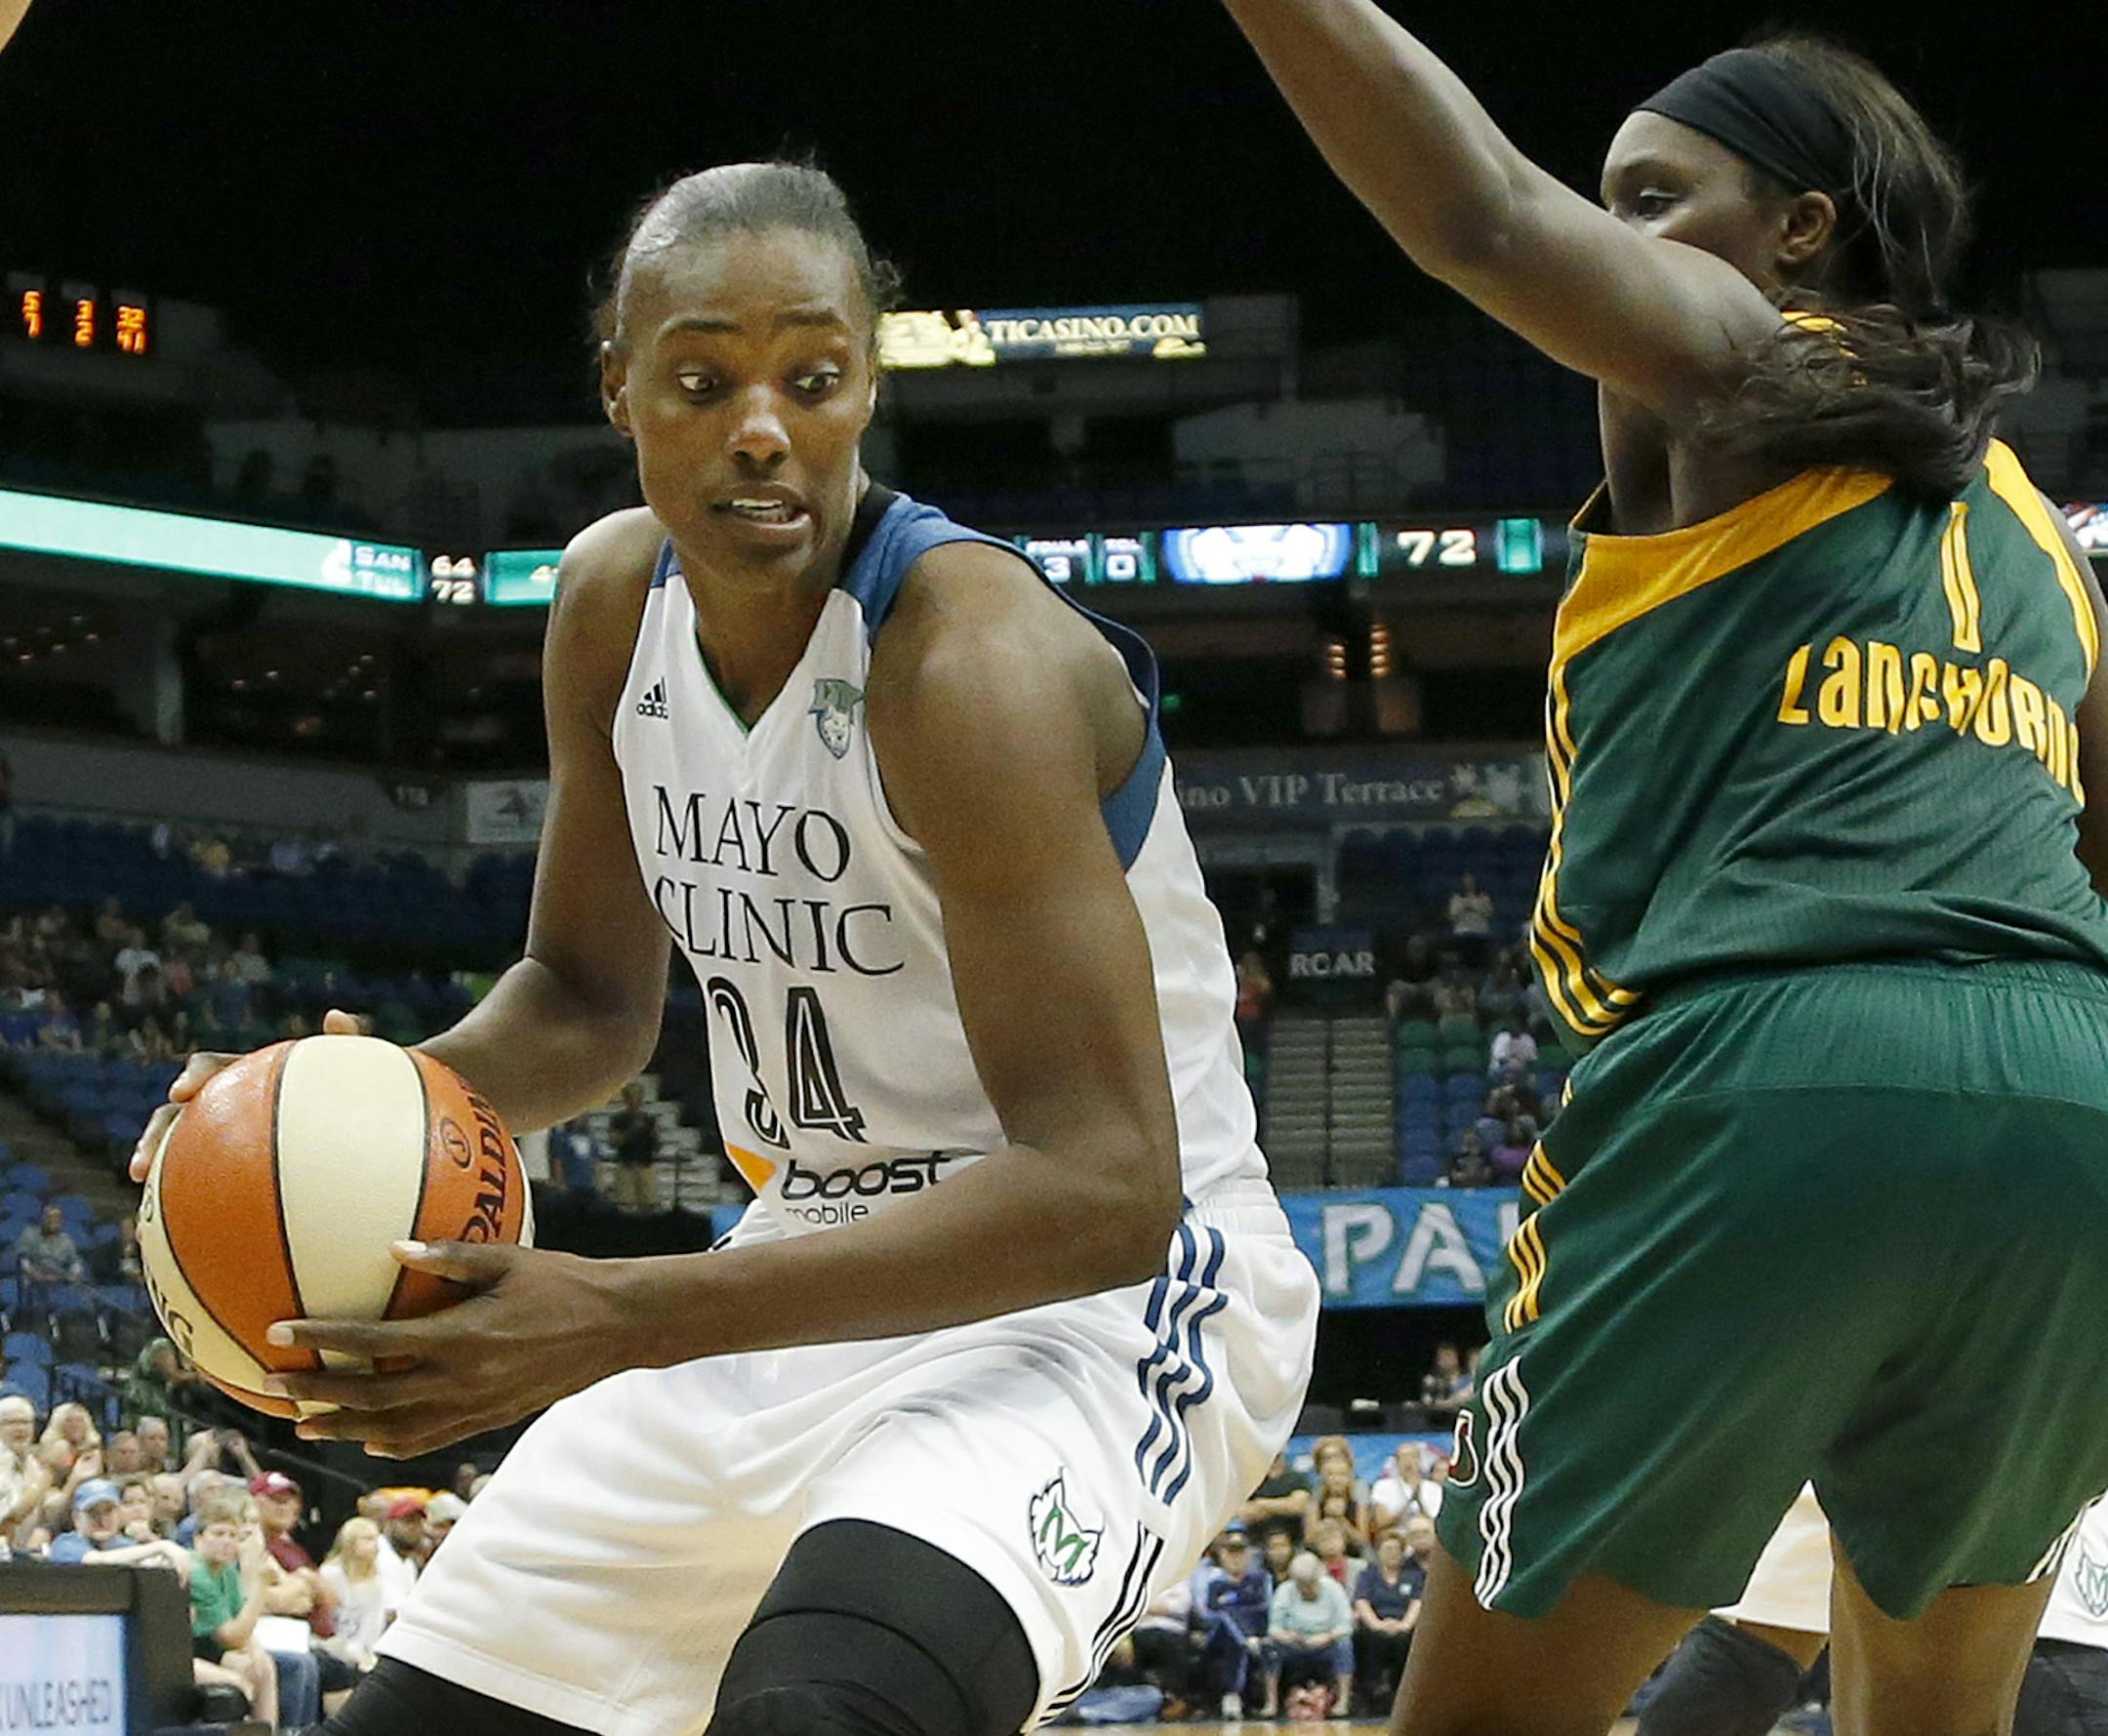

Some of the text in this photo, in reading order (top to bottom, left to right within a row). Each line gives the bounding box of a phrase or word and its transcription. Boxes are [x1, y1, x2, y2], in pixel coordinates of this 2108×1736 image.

[986, 313, 1199, 343] TICASINO.COM
[1397, 528, 1477, 567] 72
[431, 554, 475, 579] 64
[1106, 553, 1136, 581] 0
[432, 579, 474, 603] 72
[1237, 776, 1309, 806] VIP
[1318, 773, 1444, 804] Terrace
[653, 785, 851, 882] MAYO
[653, 876, 905, 976] CLINIC
[781, 1151, 952, 1200] boost
[786, 1202, 869, 1225] mobile
